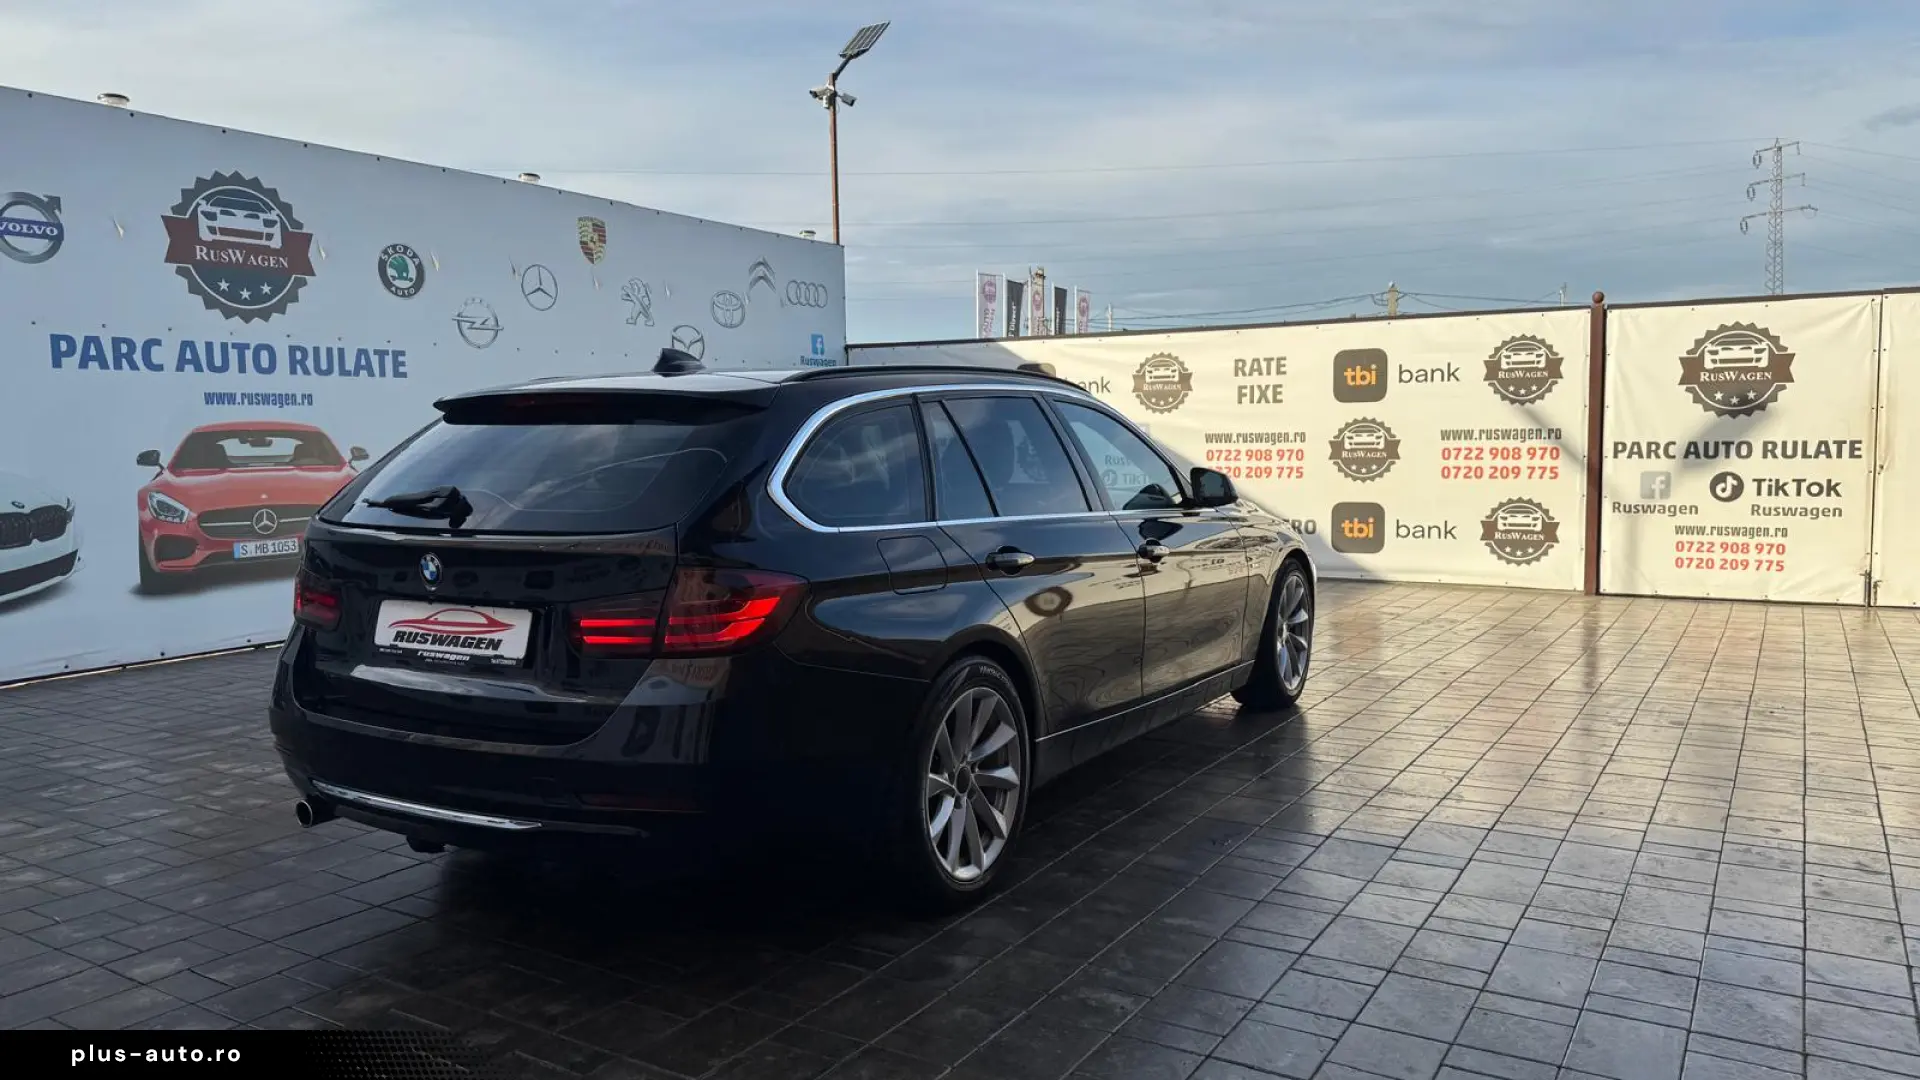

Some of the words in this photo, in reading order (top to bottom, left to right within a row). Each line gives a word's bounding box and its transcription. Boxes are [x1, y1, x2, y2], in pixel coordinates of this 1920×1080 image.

[0, 221, 58, 236] VOLVO
[49, 333, 164, 371] PARC
[175, 340, 277, 375] AUTO
[288, 344, 408, 378] RULATE
[1234, 356, 1287, 377] RATE
[1344, 364, 1377, 386] tbi
[1398, 362, 1461, 384] bank
[204, 391, 314, 409] www.ruswagen.ro
[1237, 384, 1283, 405] FIXE
[1205, 431, 1306, 445] www.ruswagen.ro
[1440, 428, 1562, 443] www.ruswagen.ro
[1206, 449, 1242, 461] 0722
[1245, 449, 1272, 461] 908
[1276, 449, 1304, 461] 970
[1441, 447, 1484, 461] 0722
[1489, 447, 1522, 461] 908
[1526, 446, 1561, 460] 970
[1612, 440, 1677, 459] PARC
[1683, 440, 1753, 459] AUTO
[1762, 439, 1863, 459] RULATE
[1245, 466, 1272, 478] 209
[1276, 466, 1304, 479] 775
[1441, 466, 1484, 480] 0720
[1488, 466, 1521, 480] 209
[1527, 466, 1559, 480] 775
[1752, 478, 1842, 498] TikTok
[1612, 501, 1699, 516] Ruswagen
[1750, 503, 1843, 519] Ruswagen
[1341, 517, 1375, 539] tbi
[1396, 519, 1458, 540] bank
[1674, 525, 1788, 539] www.ruswagen.ro
[255, 543, 269, 554] MB
[271, 540, 297, 553] 1053
[1675, 540, 1715, 554] 0722
[1719, 541, 1750, 555] 908
[1754, 542, 1786, 556] 970
[1675, 557, 1715, 570] 0720
[1719, 558, 1750, 571] 209
[1754, 559, 1785, 572] 775
[393, 630, 503, 651] RUSWAGEN
[417, 651, 470, 661] ruswagen
